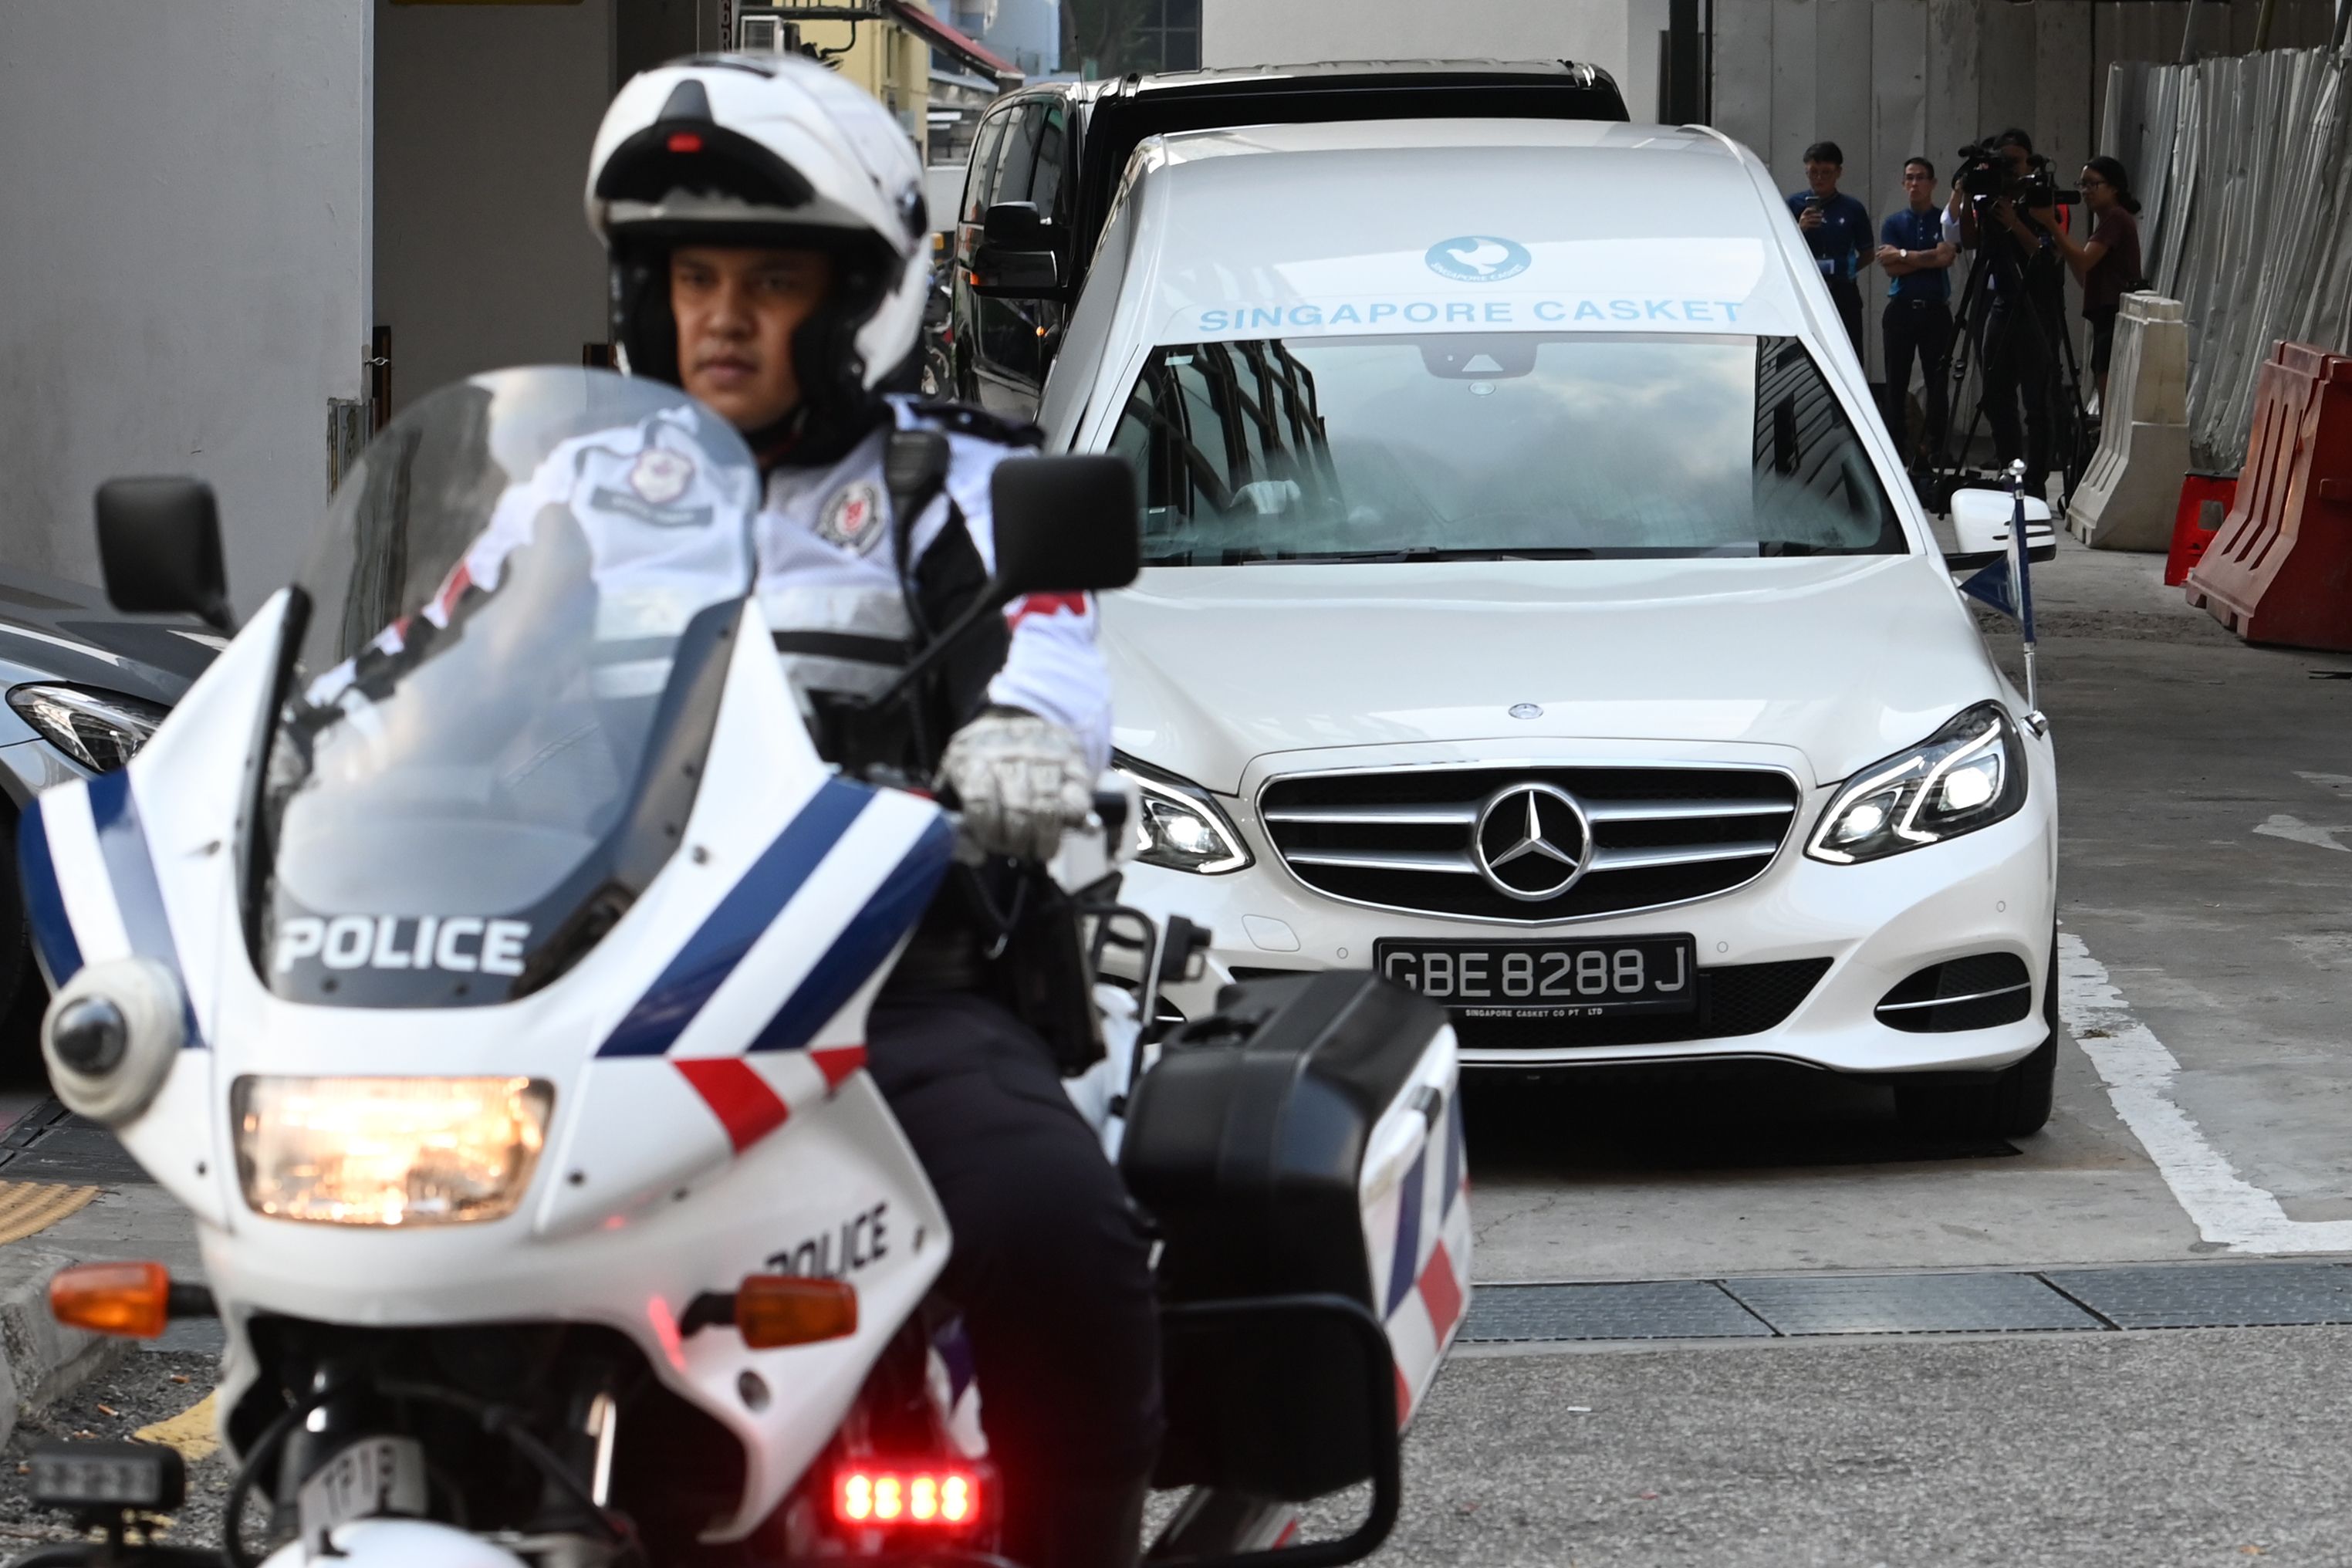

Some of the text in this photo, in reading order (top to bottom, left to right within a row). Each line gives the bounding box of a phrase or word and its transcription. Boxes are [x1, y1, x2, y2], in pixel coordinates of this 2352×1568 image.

[1198, 299, 1742, 332] SINGAPORE CASKET
[275, 916, 532, 977] POLICE
[1385, 946, 1685, 997] GBE 8288 J
[1465, 1009, 1512, 1017] SINGAPORE
[1587, 1007, 1603, 1015] LTD
